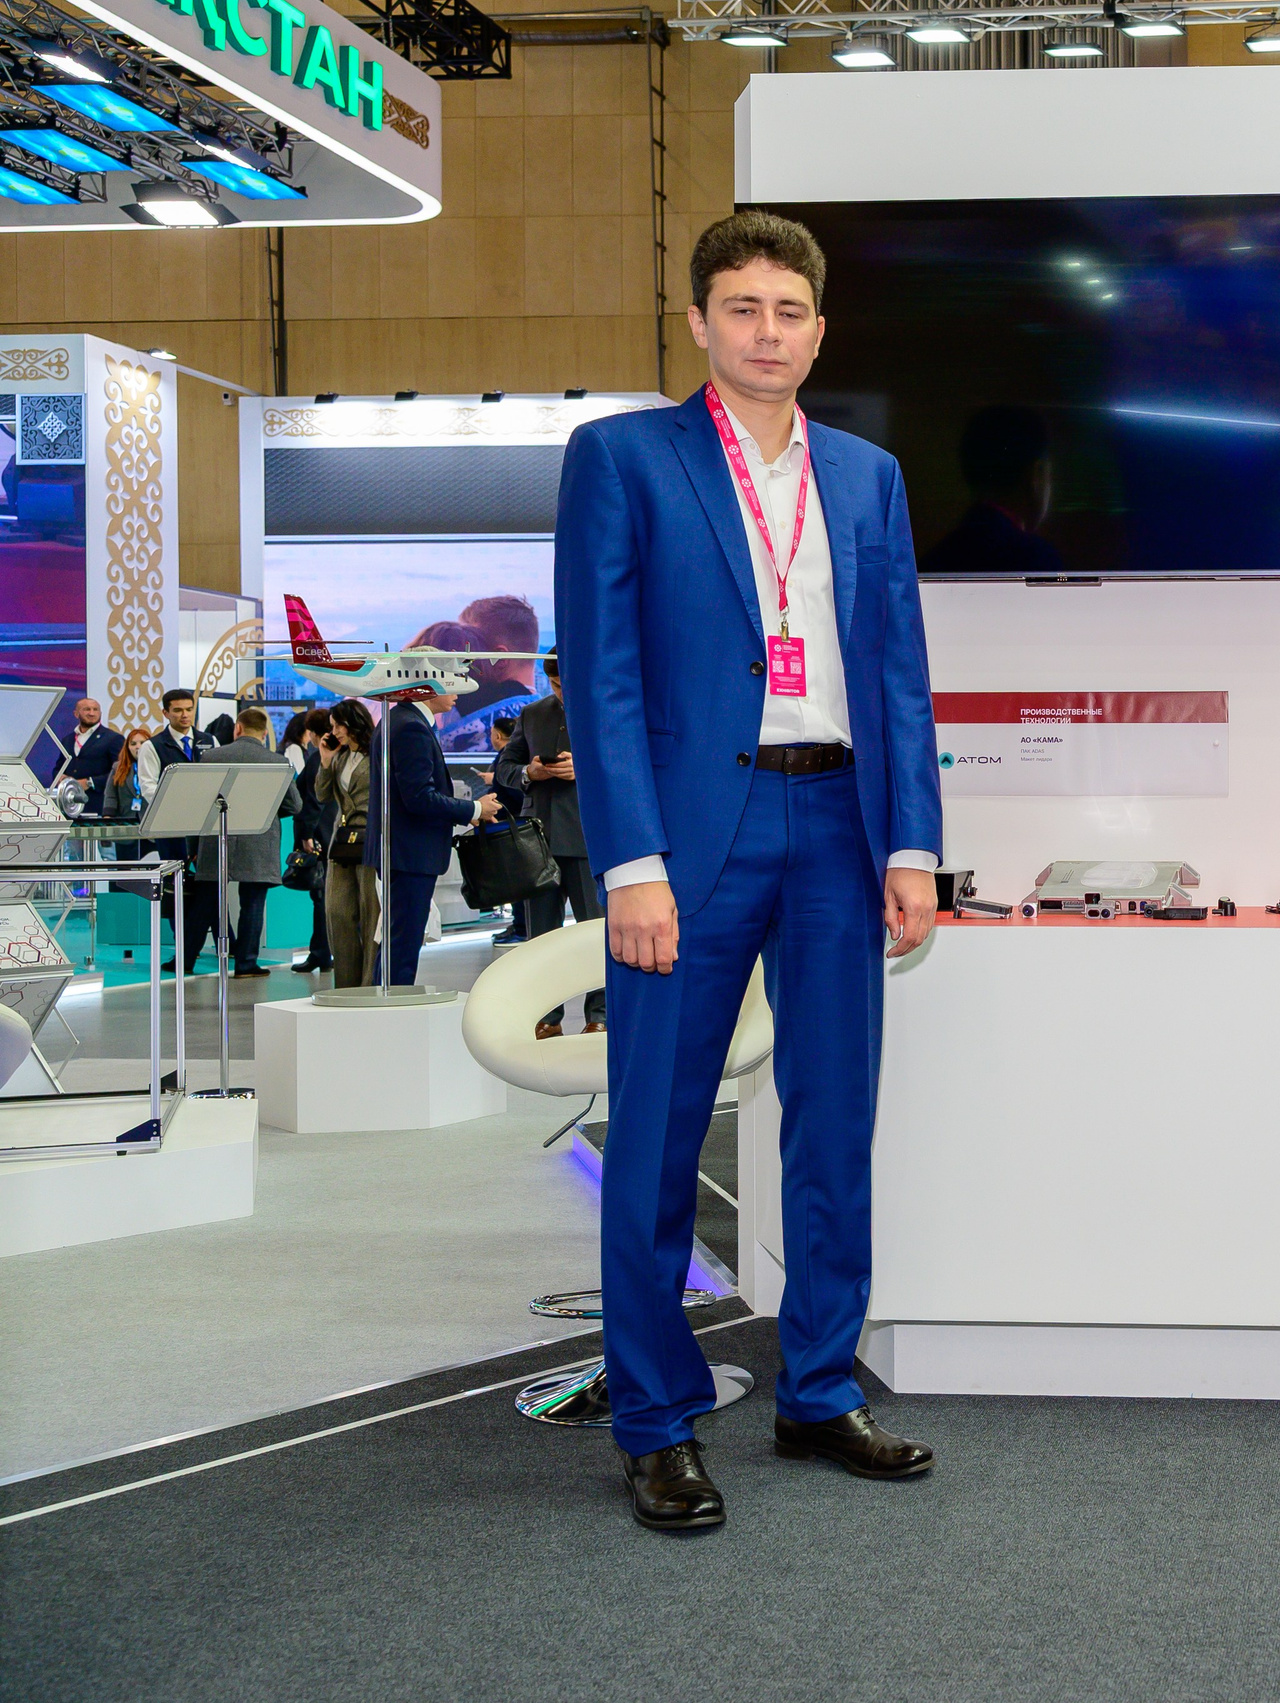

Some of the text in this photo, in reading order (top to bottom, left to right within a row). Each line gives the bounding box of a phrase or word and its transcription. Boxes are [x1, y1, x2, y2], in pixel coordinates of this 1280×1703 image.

[157, 0, 383, 131] СТАН
[295, 646, 328, 656] Освей
[1020, 708, 1103, 716] ПРОИЗВОДСТВЕННЫЕ
[1020, 736, 1063, 744] АО «КАМА»
